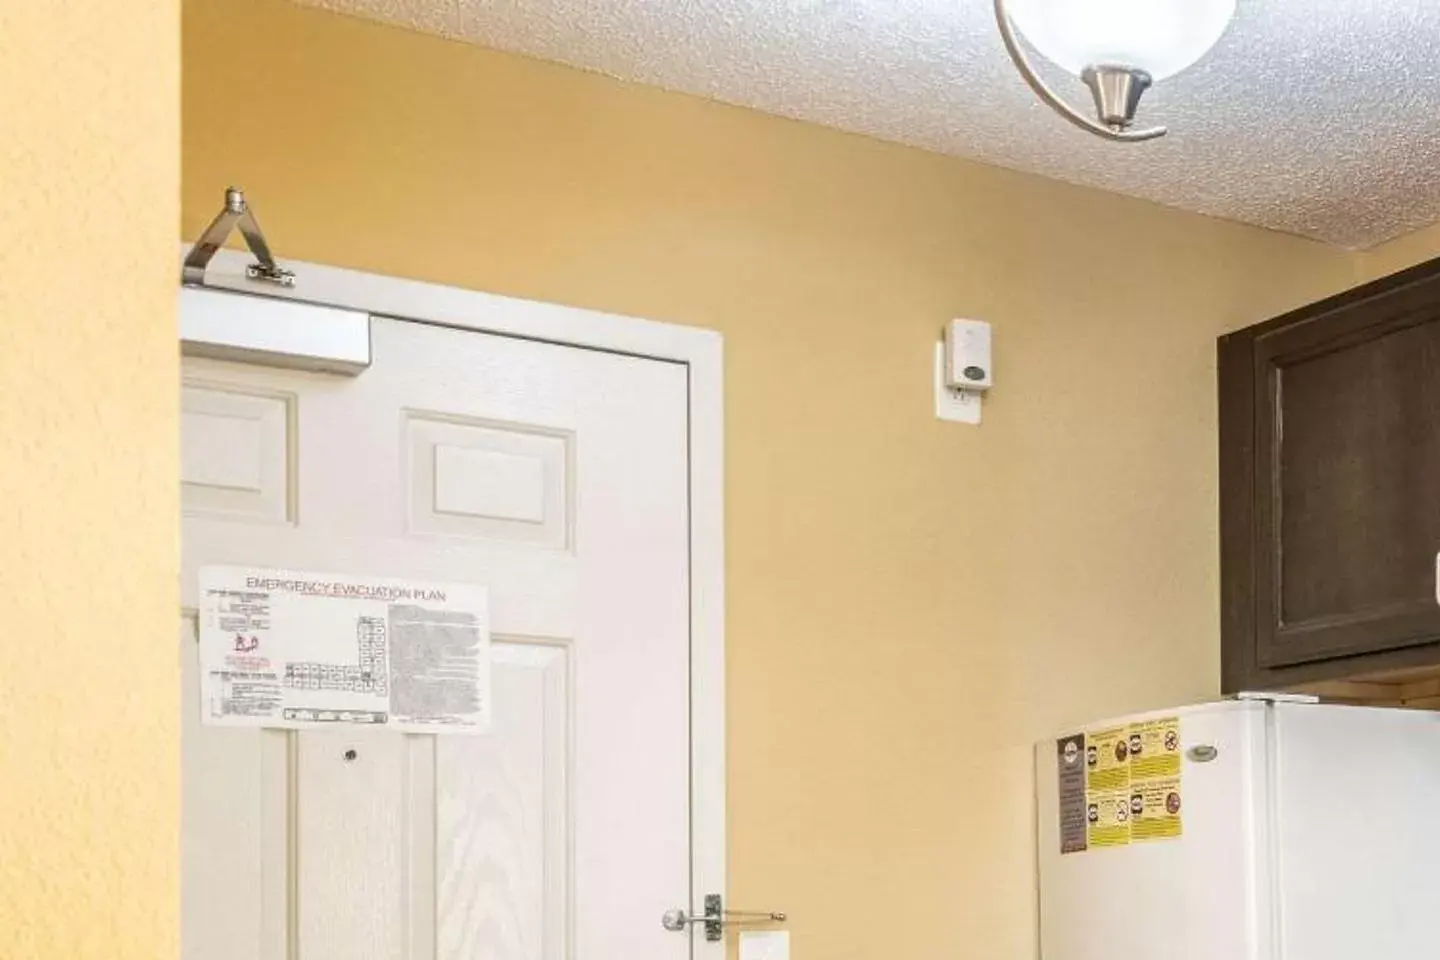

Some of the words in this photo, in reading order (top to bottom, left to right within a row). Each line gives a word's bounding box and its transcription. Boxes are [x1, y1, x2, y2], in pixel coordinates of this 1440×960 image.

[246, 577, 330, 592] EMERGENCY
[333, 583, 411, 599] EVACUATION
[414, 589, 446, 602] PLAN
